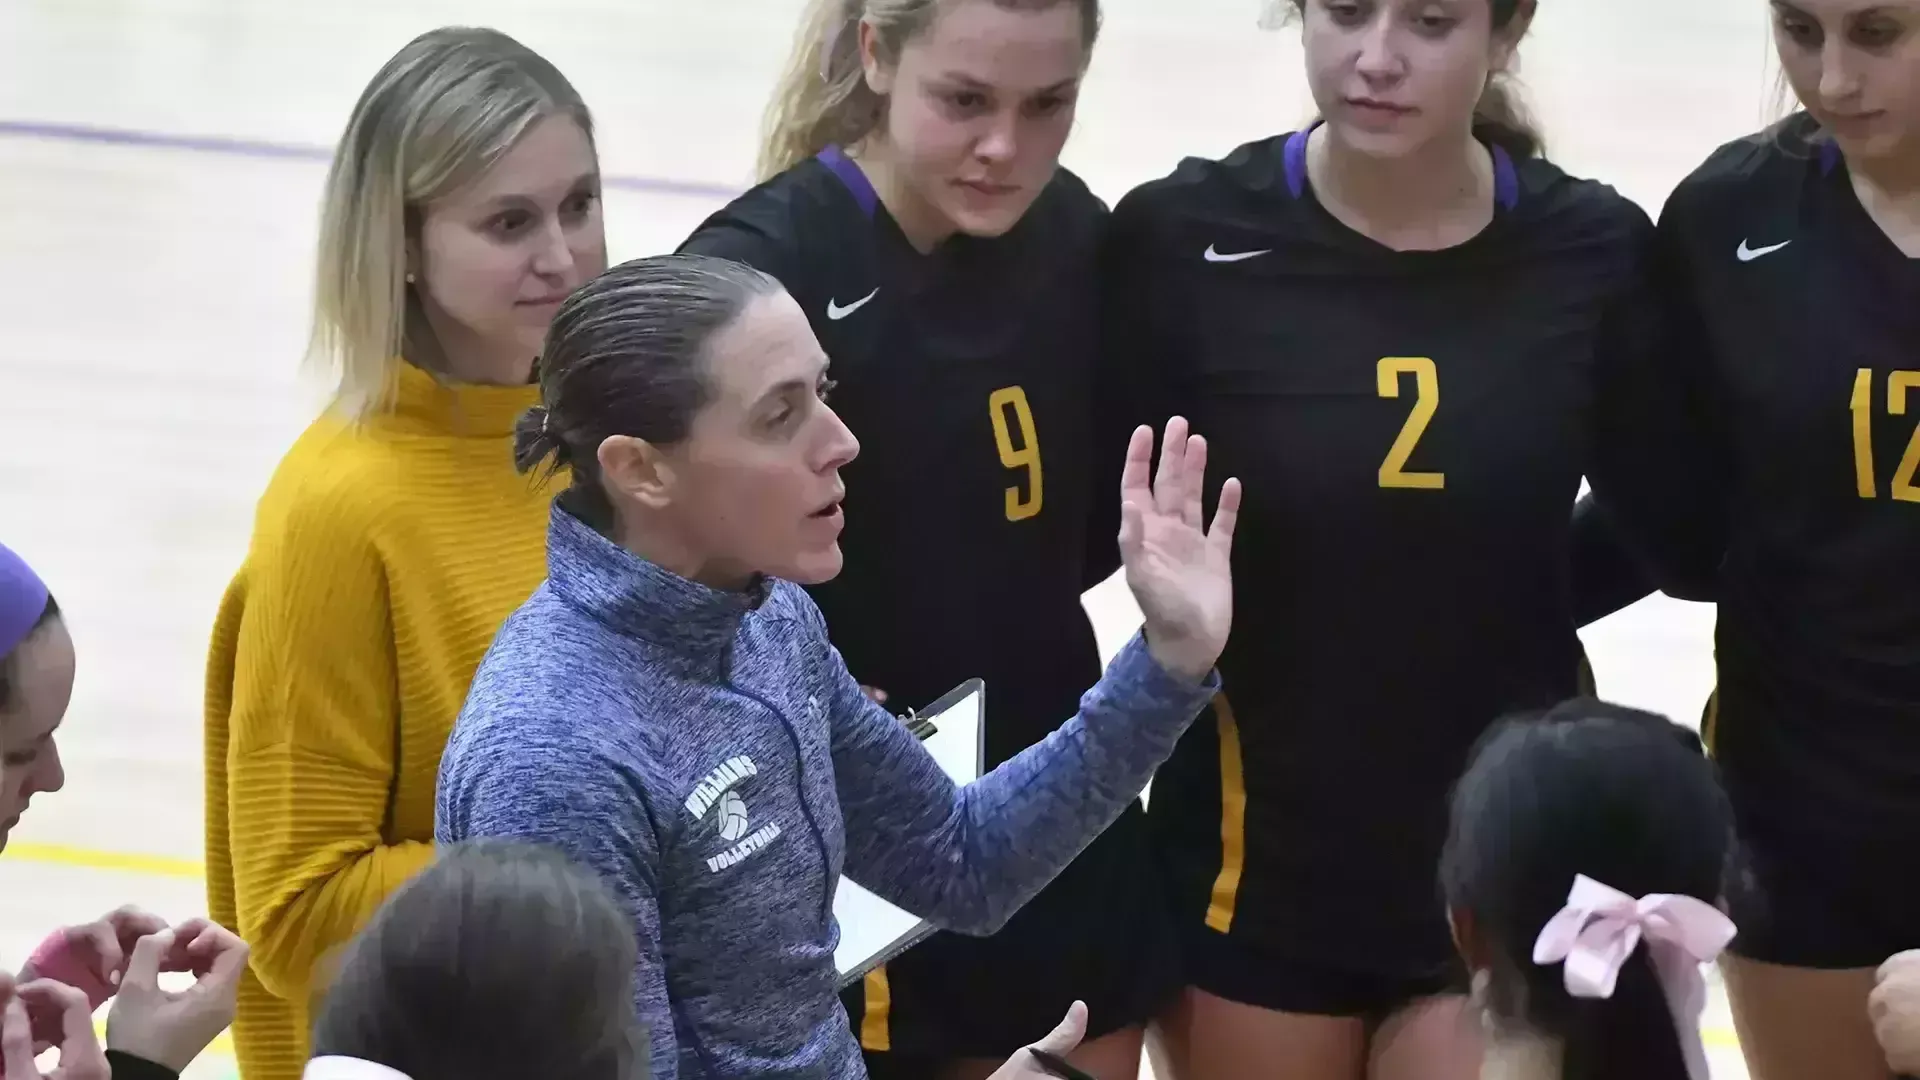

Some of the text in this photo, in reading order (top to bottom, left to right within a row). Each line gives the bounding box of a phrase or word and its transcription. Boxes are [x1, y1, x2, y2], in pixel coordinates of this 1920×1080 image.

[988, 386, 1043, 520] 9
[1377, 357, 1443, 489] 2
[684, 755, 758, 820] WILLIAMS
[706, 821, 781, 873] VOLLEYBALL
